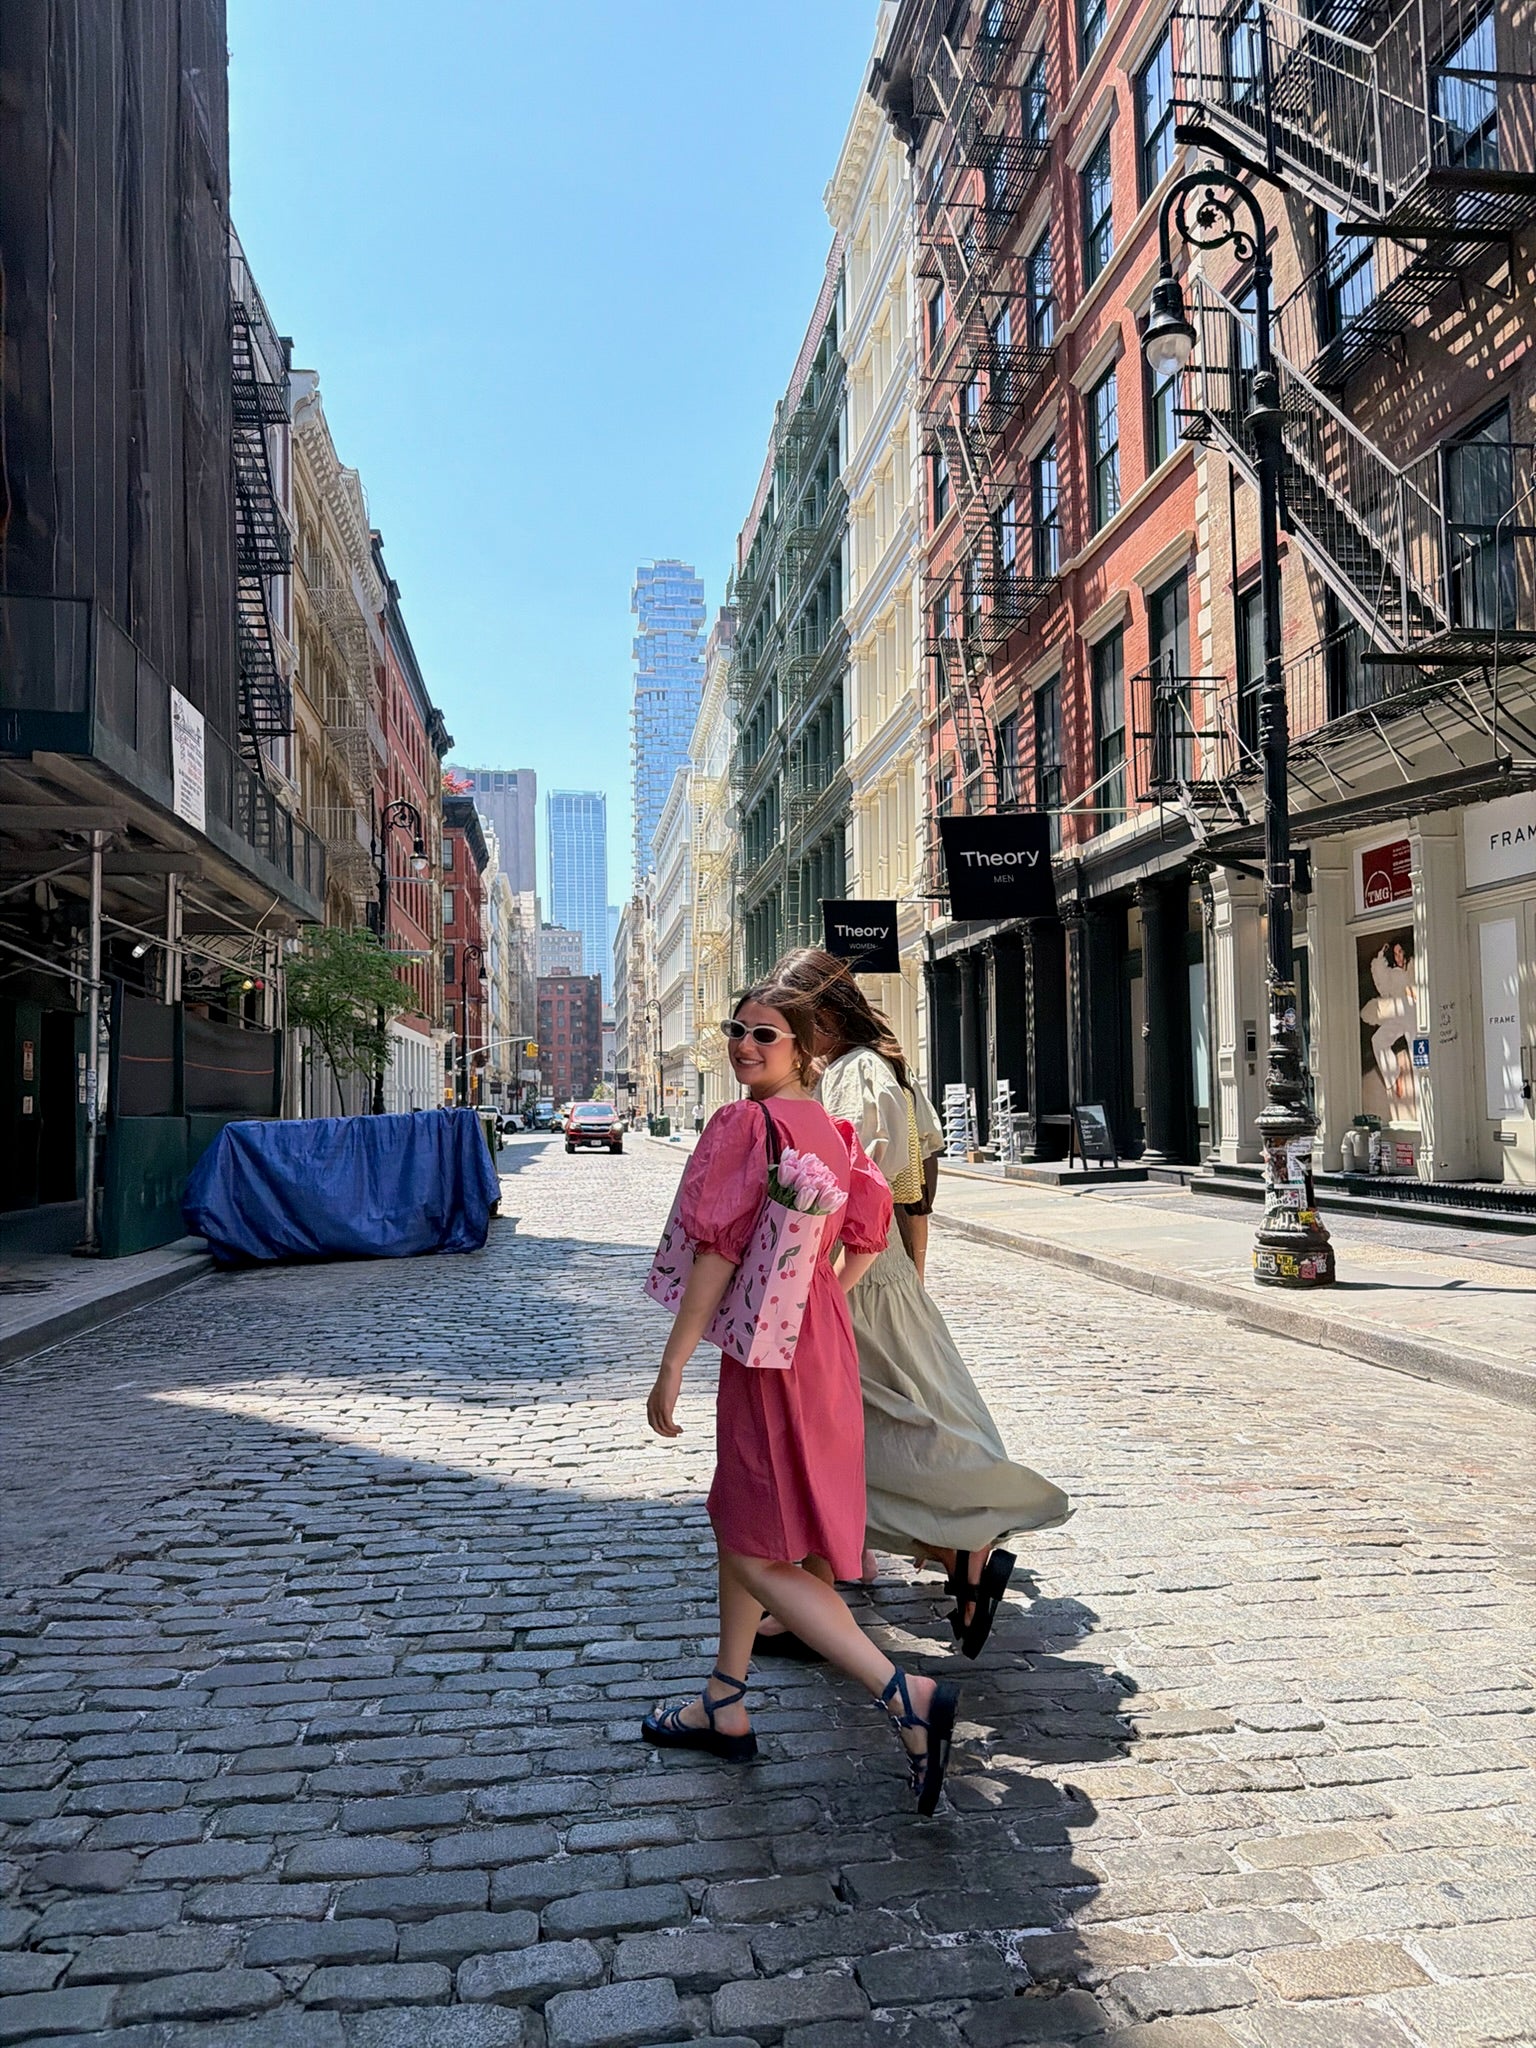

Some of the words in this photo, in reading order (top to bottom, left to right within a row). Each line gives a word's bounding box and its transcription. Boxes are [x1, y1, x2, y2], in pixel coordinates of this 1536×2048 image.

[960, 850, 1039, 867] Theory
[993, 875, 1015, 883] MEN
[1368, 887, 1389, 903] TMG
[834, 925, 889, 939] Theory
[1489, 1015, 1515, 1024] FRAME
